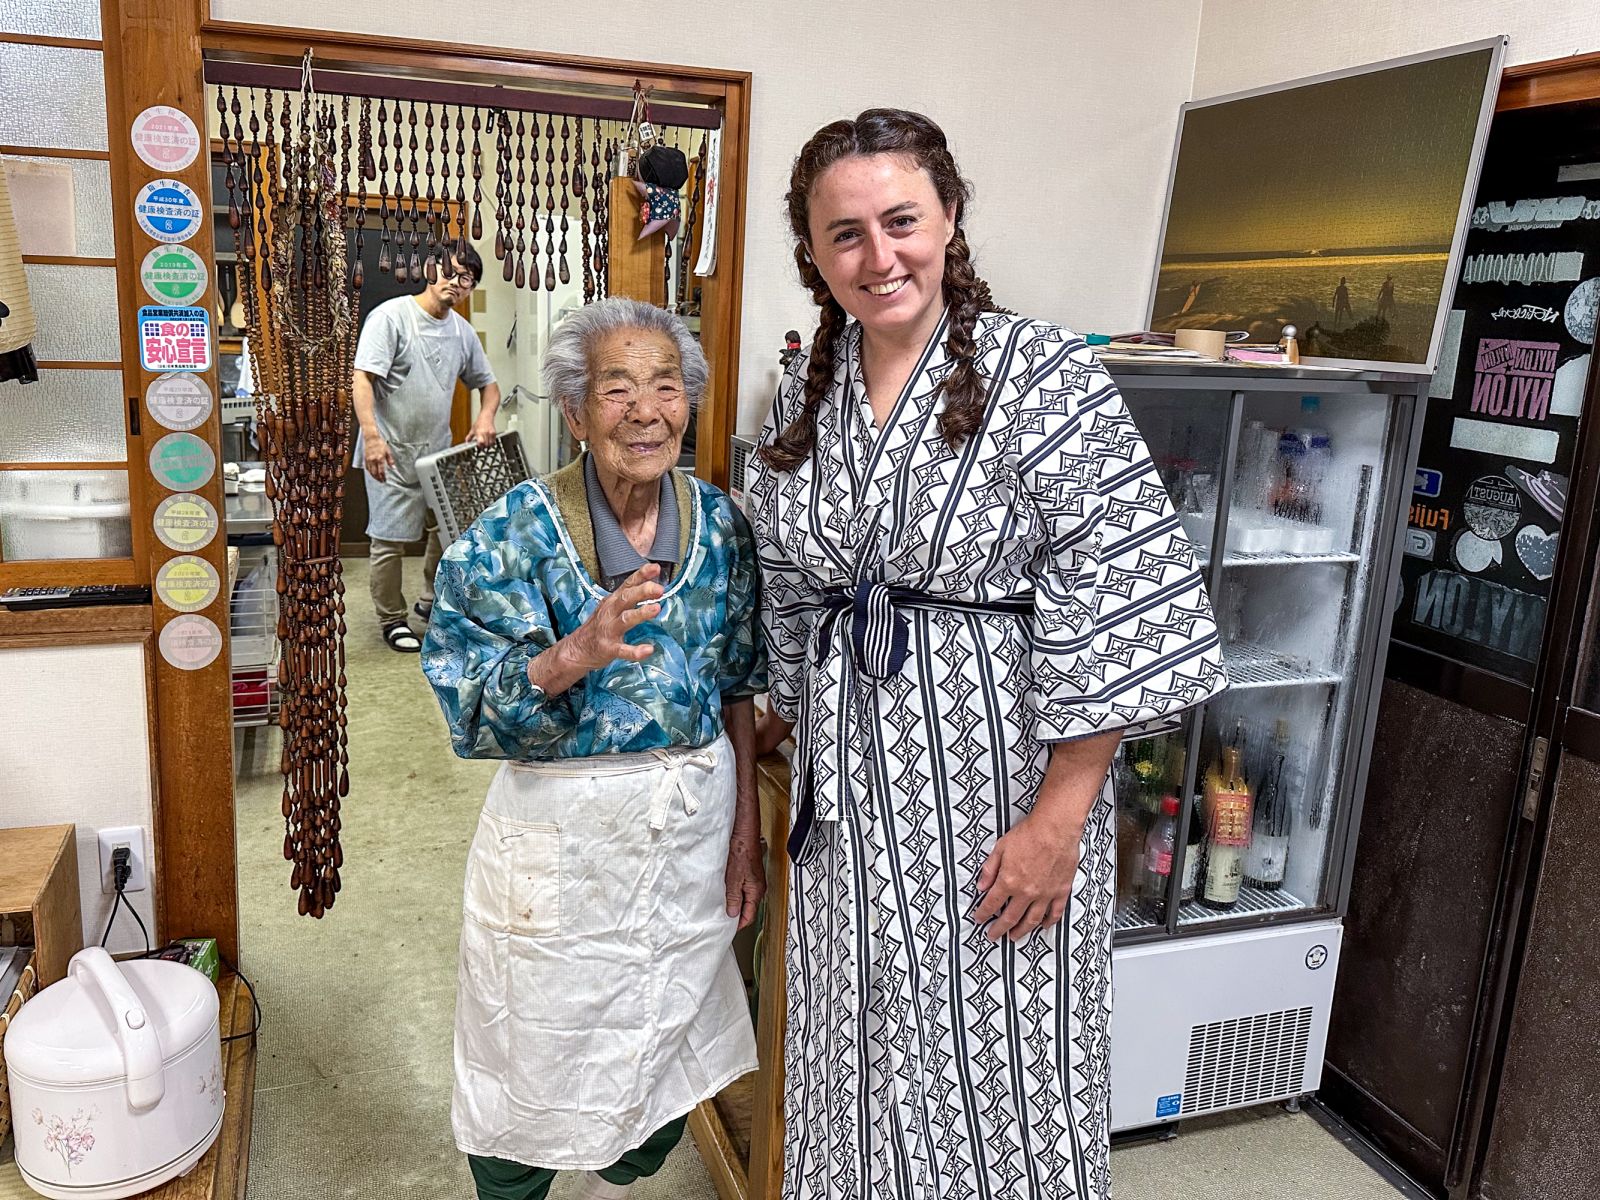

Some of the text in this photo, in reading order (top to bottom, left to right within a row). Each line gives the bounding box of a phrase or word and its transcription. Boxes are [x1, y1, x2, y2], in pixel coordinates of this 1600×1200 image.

[138, 204, 200, 218] 健康検査済の証
[160, 322, 190, 337] 食の
[145, 337, 206, 364] 安心宣言
